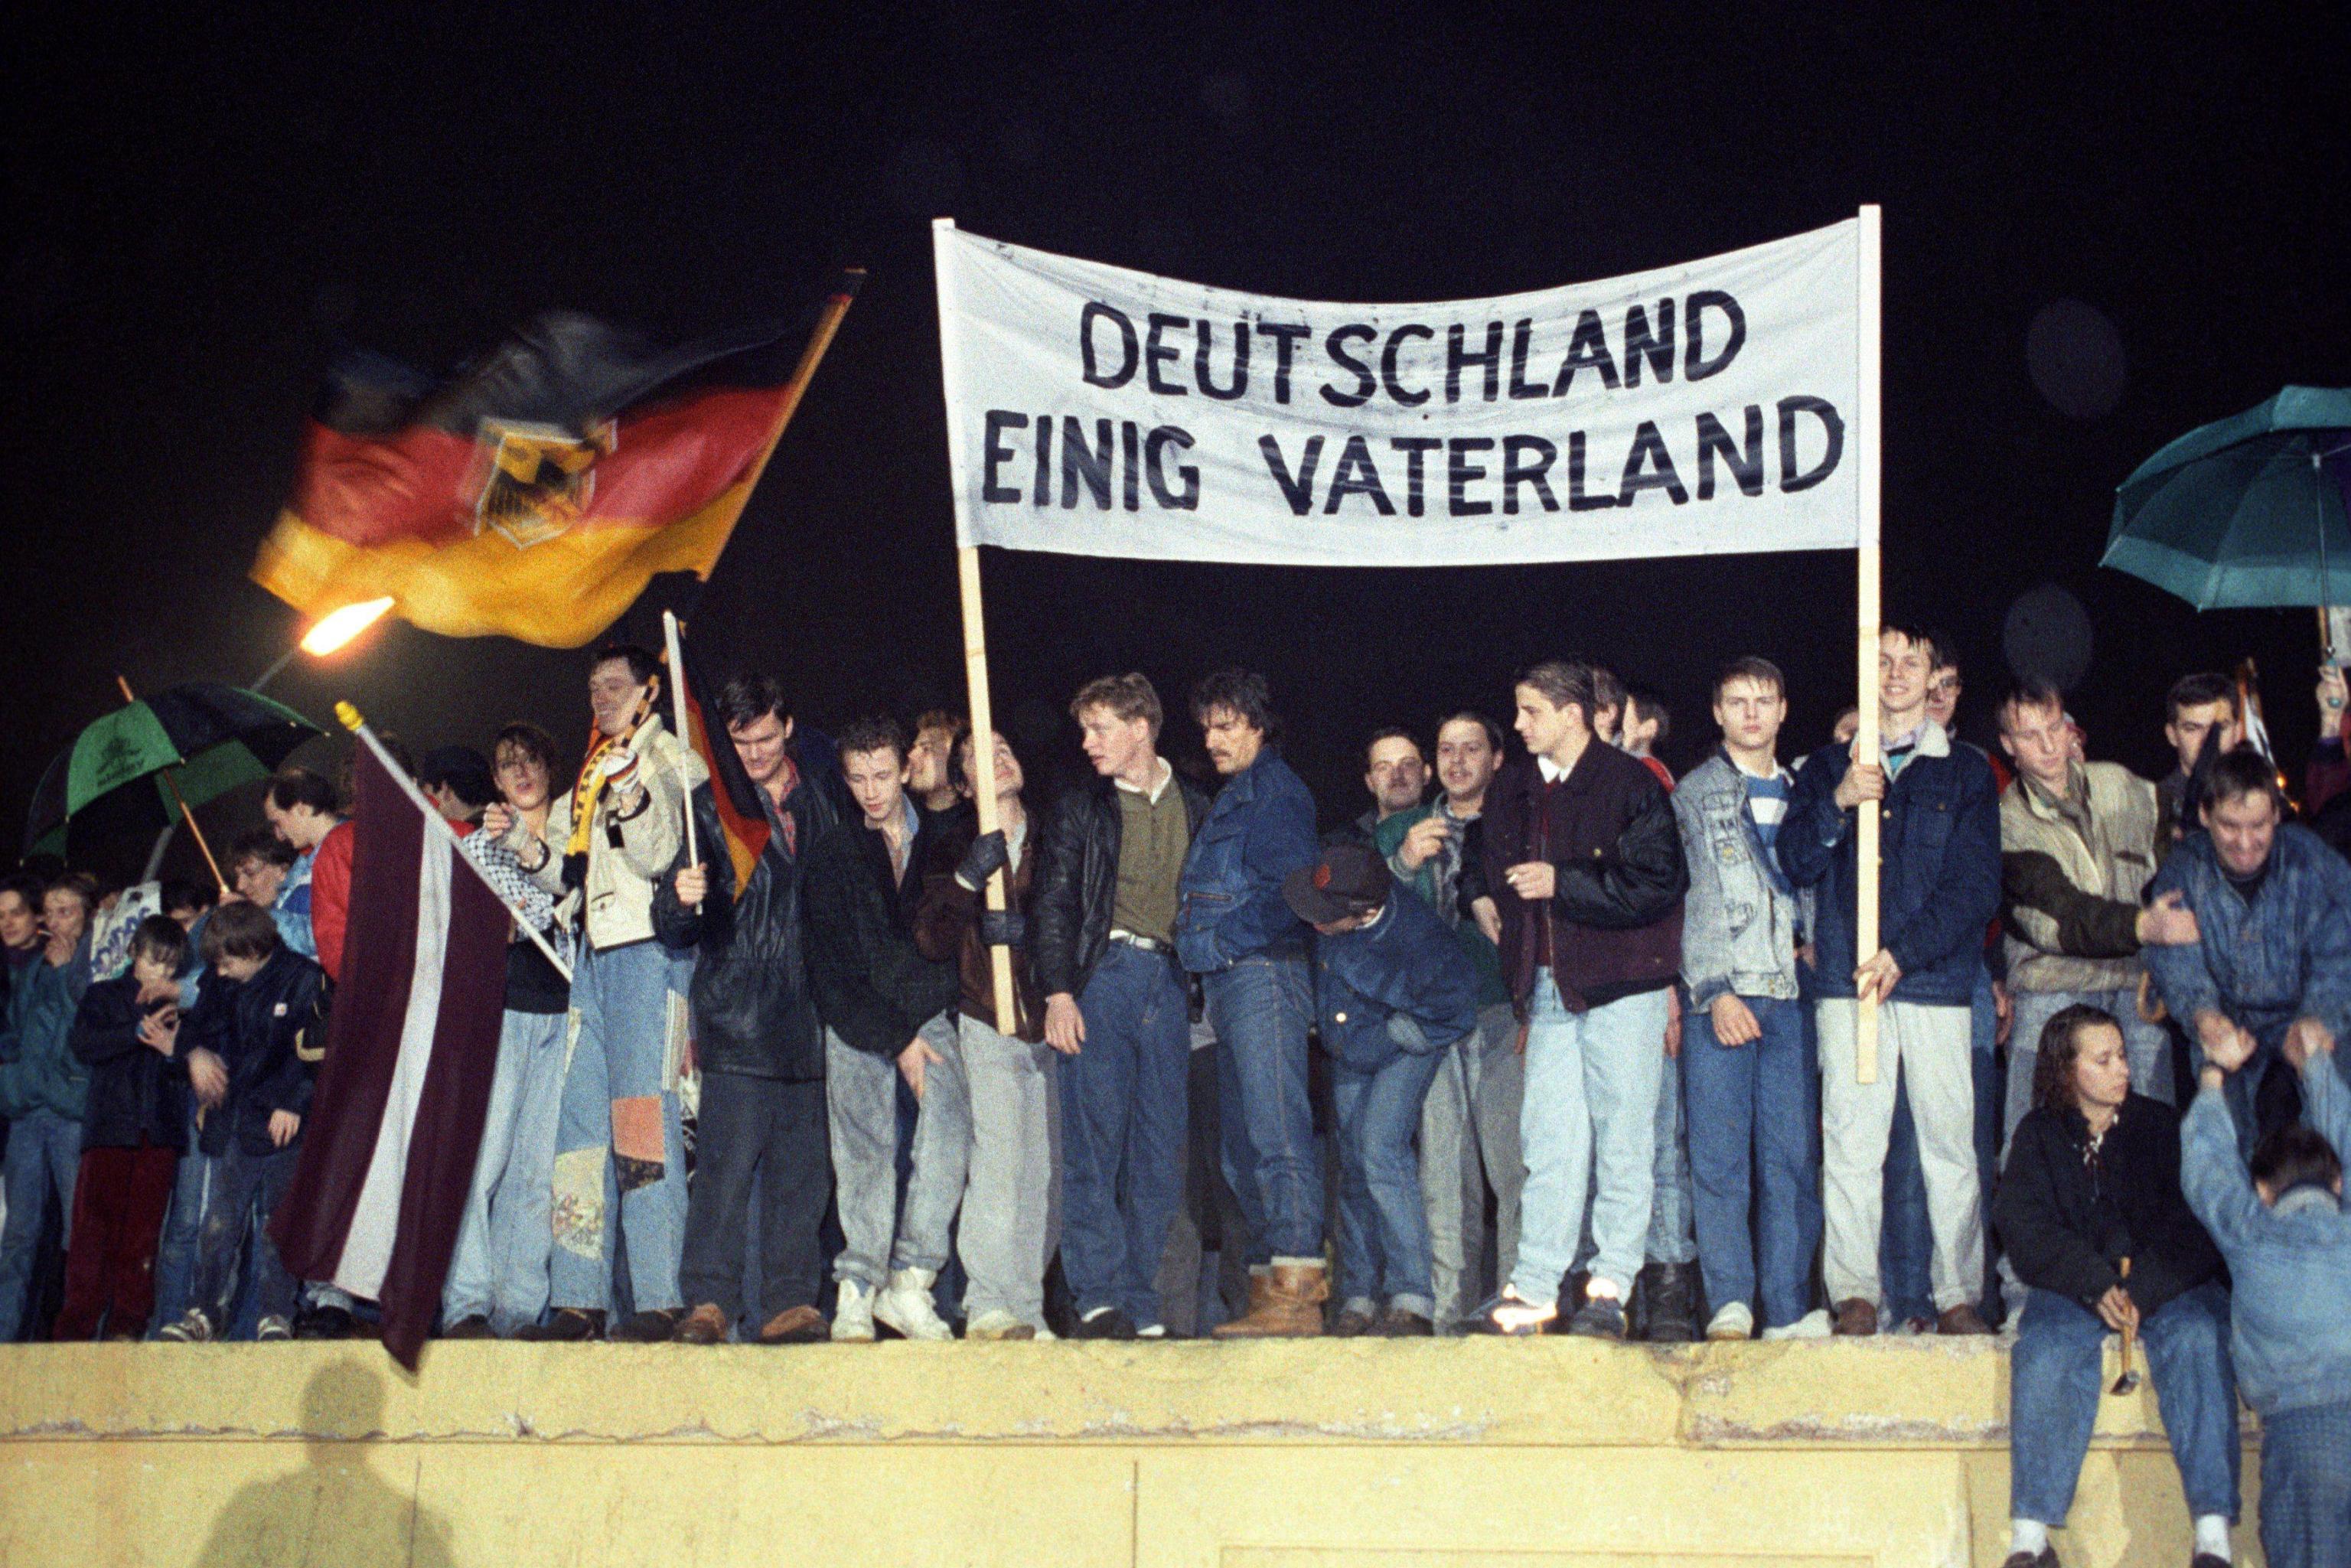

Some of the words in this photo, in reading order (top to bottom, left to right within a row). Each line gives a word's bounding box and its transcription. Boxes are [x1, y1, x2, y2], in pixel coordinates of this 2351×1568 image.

[1080, 290, 1746, 408] DEUTSCHLAND
[982, 409, 1200, 512] EINIG
[1257, 396, 1844, 518] VATERLAND
